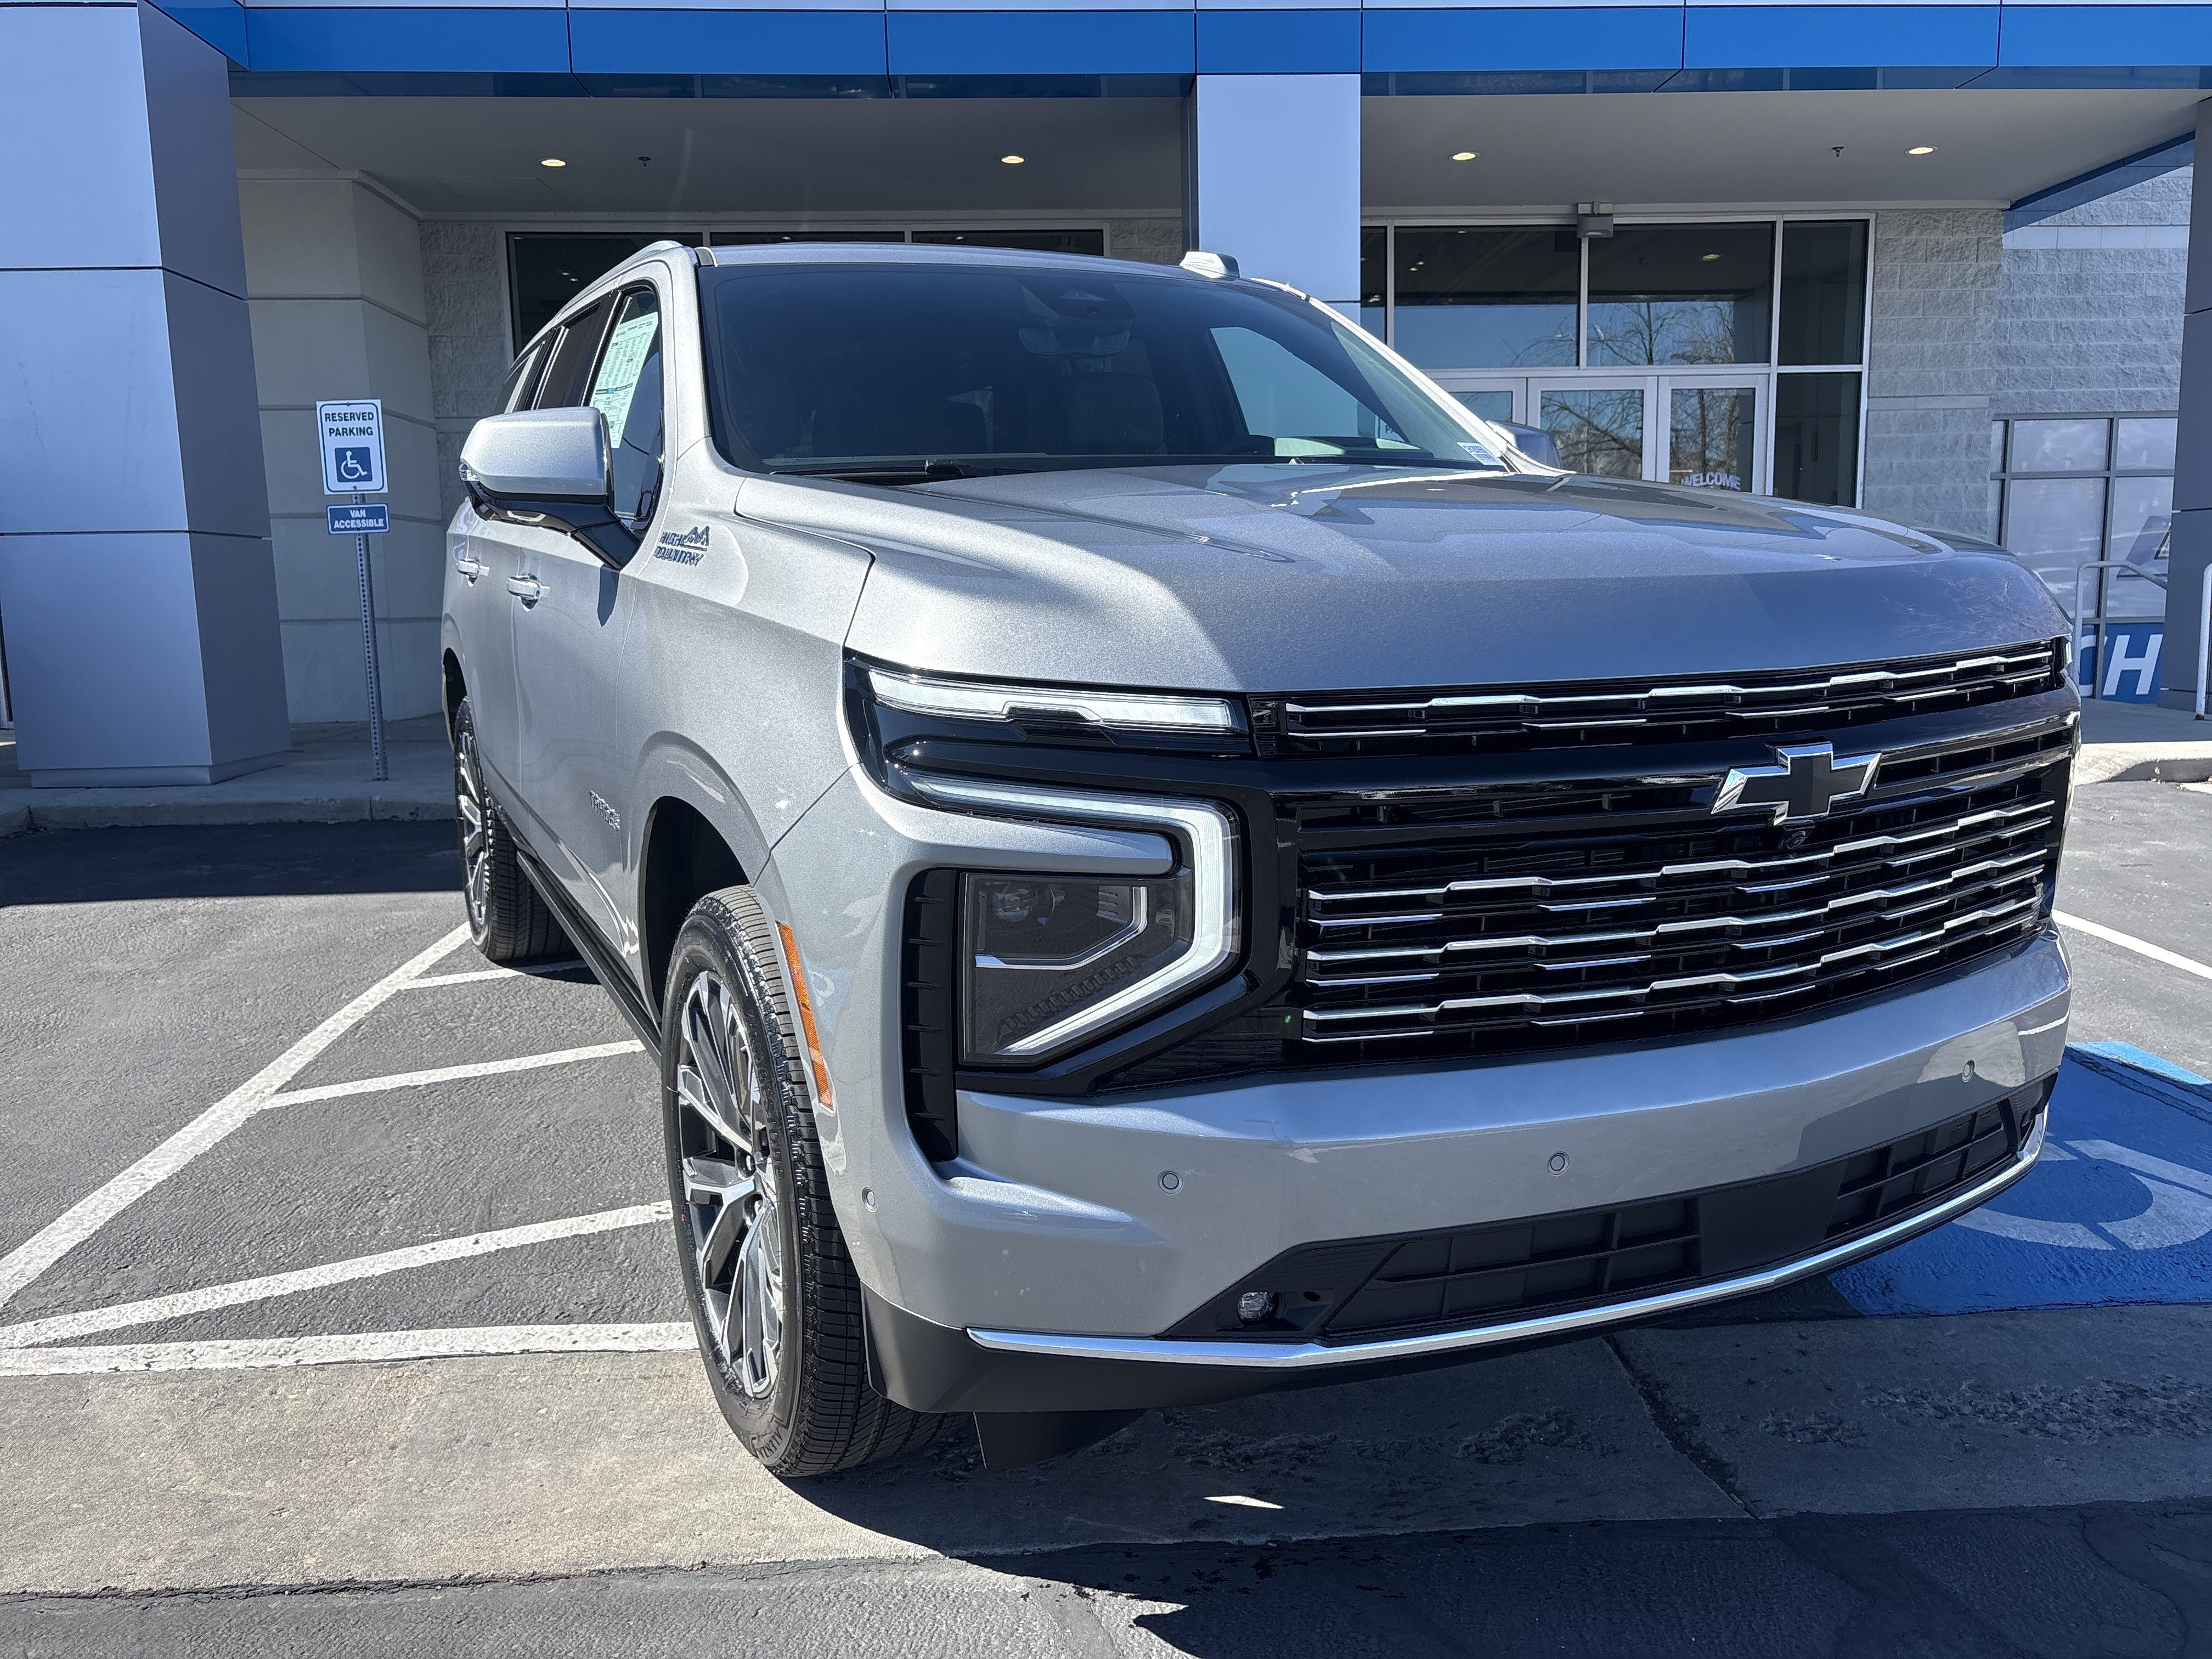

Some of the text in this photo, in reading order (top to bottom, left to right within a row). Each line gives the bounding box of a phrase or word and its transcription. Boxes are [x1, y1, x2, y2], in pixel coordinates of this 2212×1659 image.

[324, 411, 374, 422] RESERVED
[329, 426, 374, 437] PARKING
[1680, 471, 1741, 492] WELCOME
[349, 509, 366, 518] VAN
[334, 518, 385, 529] ACCESSIBLE
